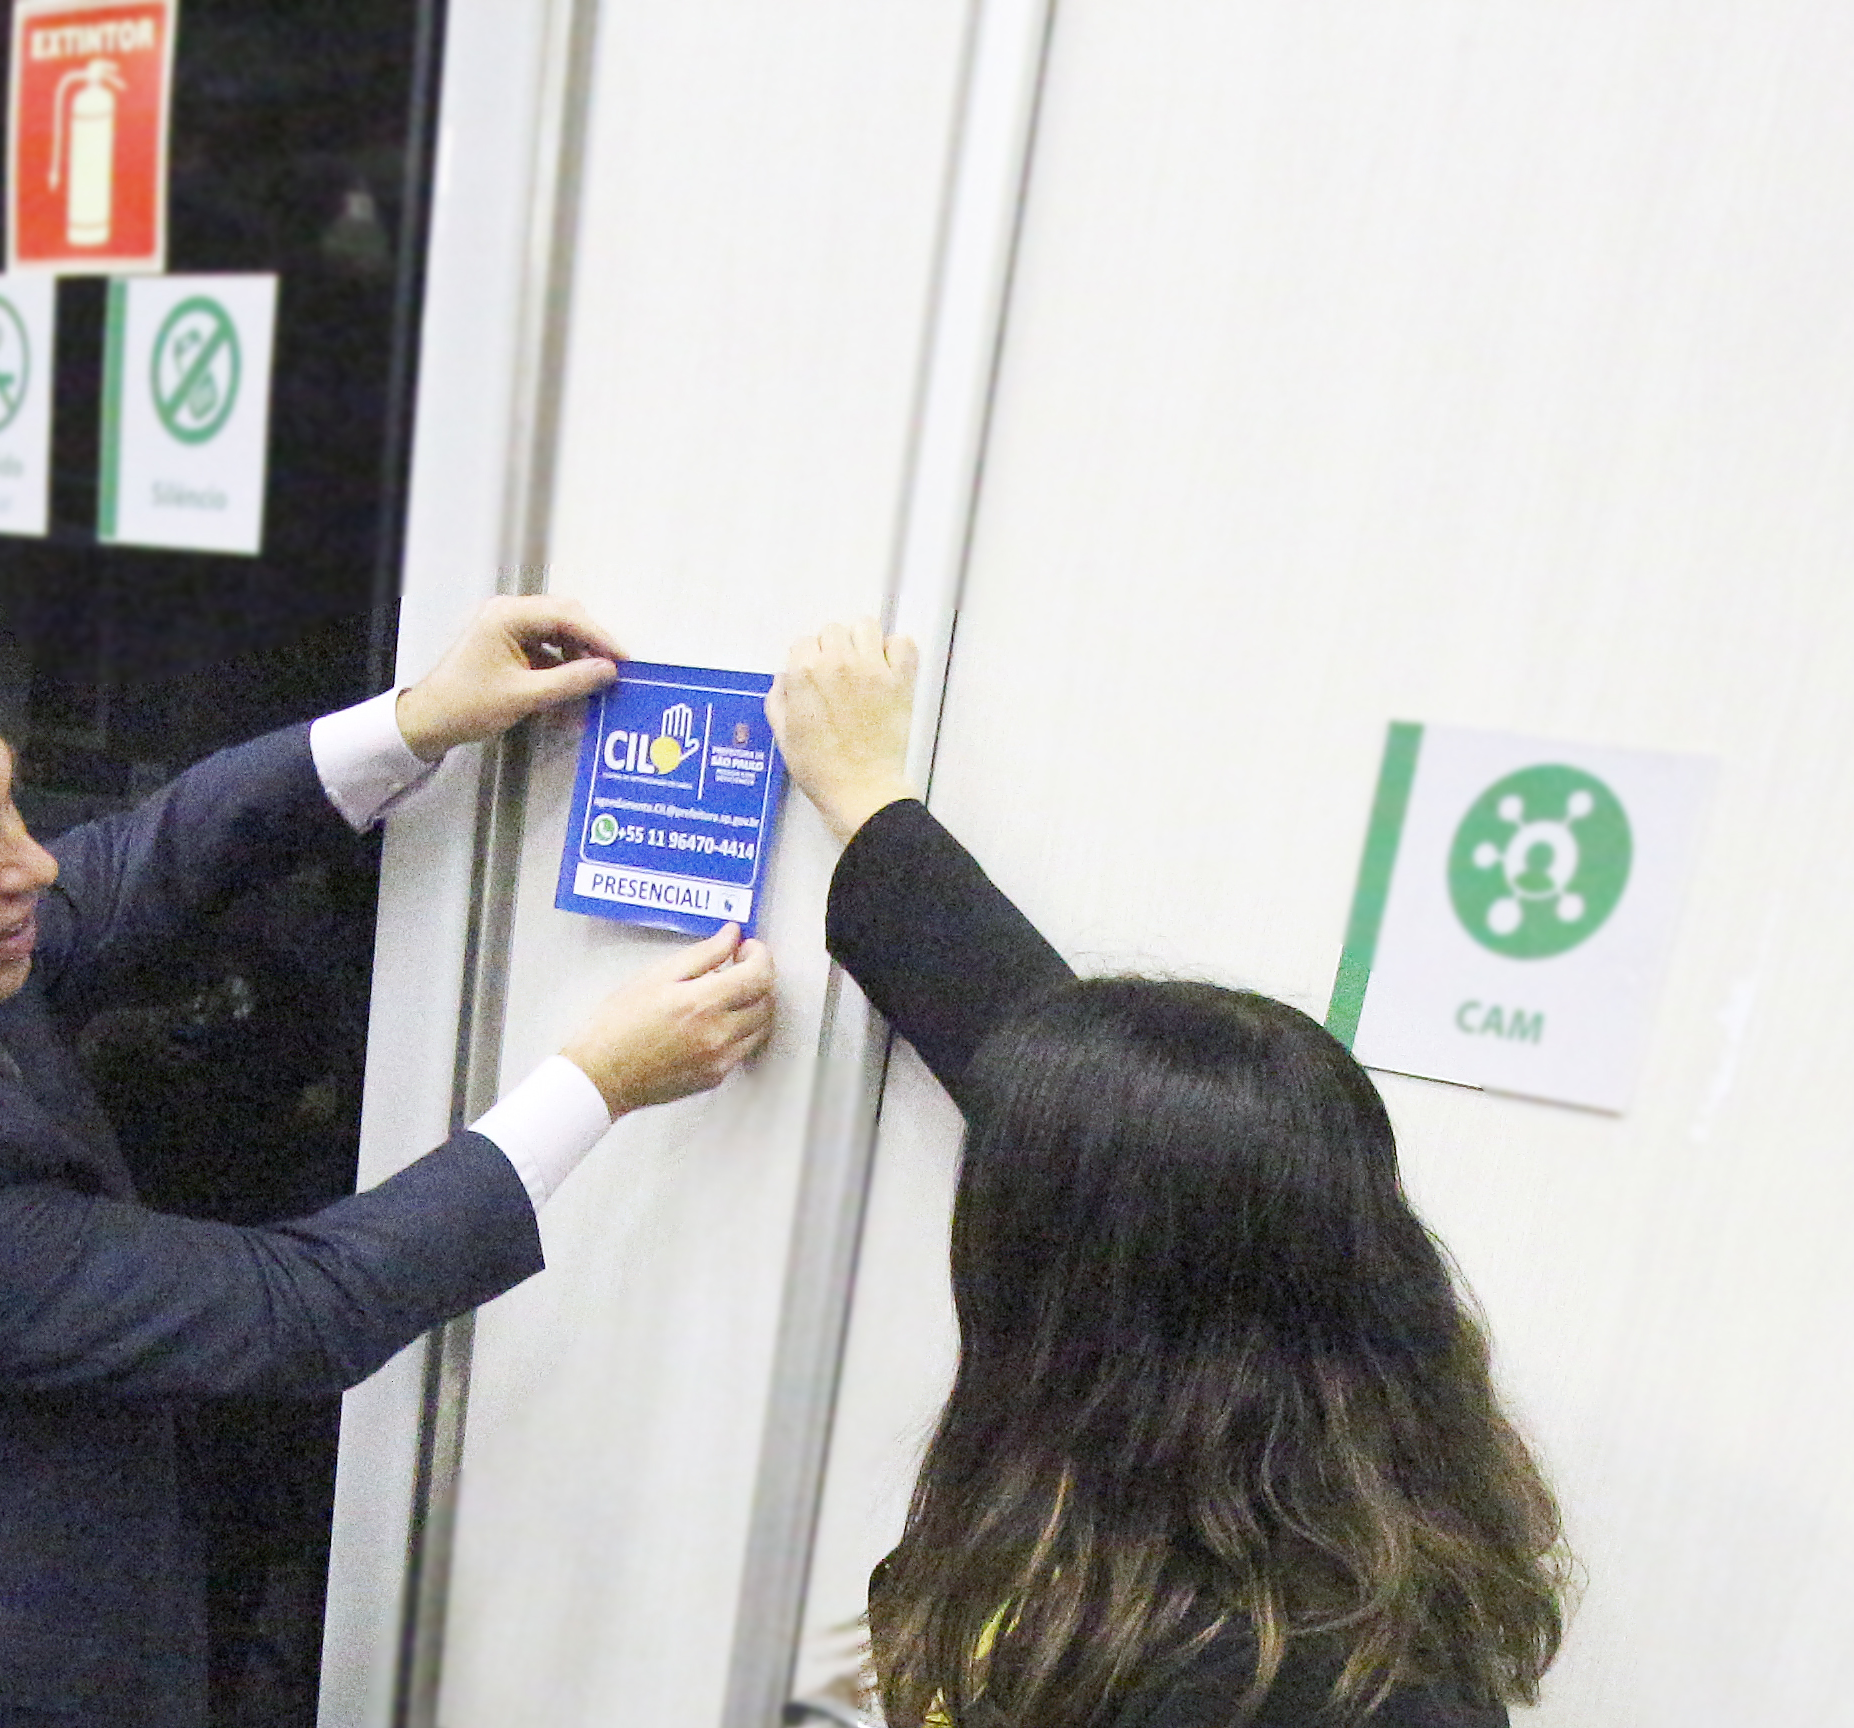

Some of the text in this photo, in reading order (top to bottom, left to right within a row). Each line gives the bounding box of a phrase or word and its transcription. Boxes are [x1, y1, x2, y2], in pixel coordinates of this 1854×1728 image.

[31, 19, 153, 59] EXTINTOR
[618, 825, 755, 860] +55 11 96470-4414
[592, 873, 710, 909] PRESENCIAL!
[1455, 1000, 1546, 1045] CAM
